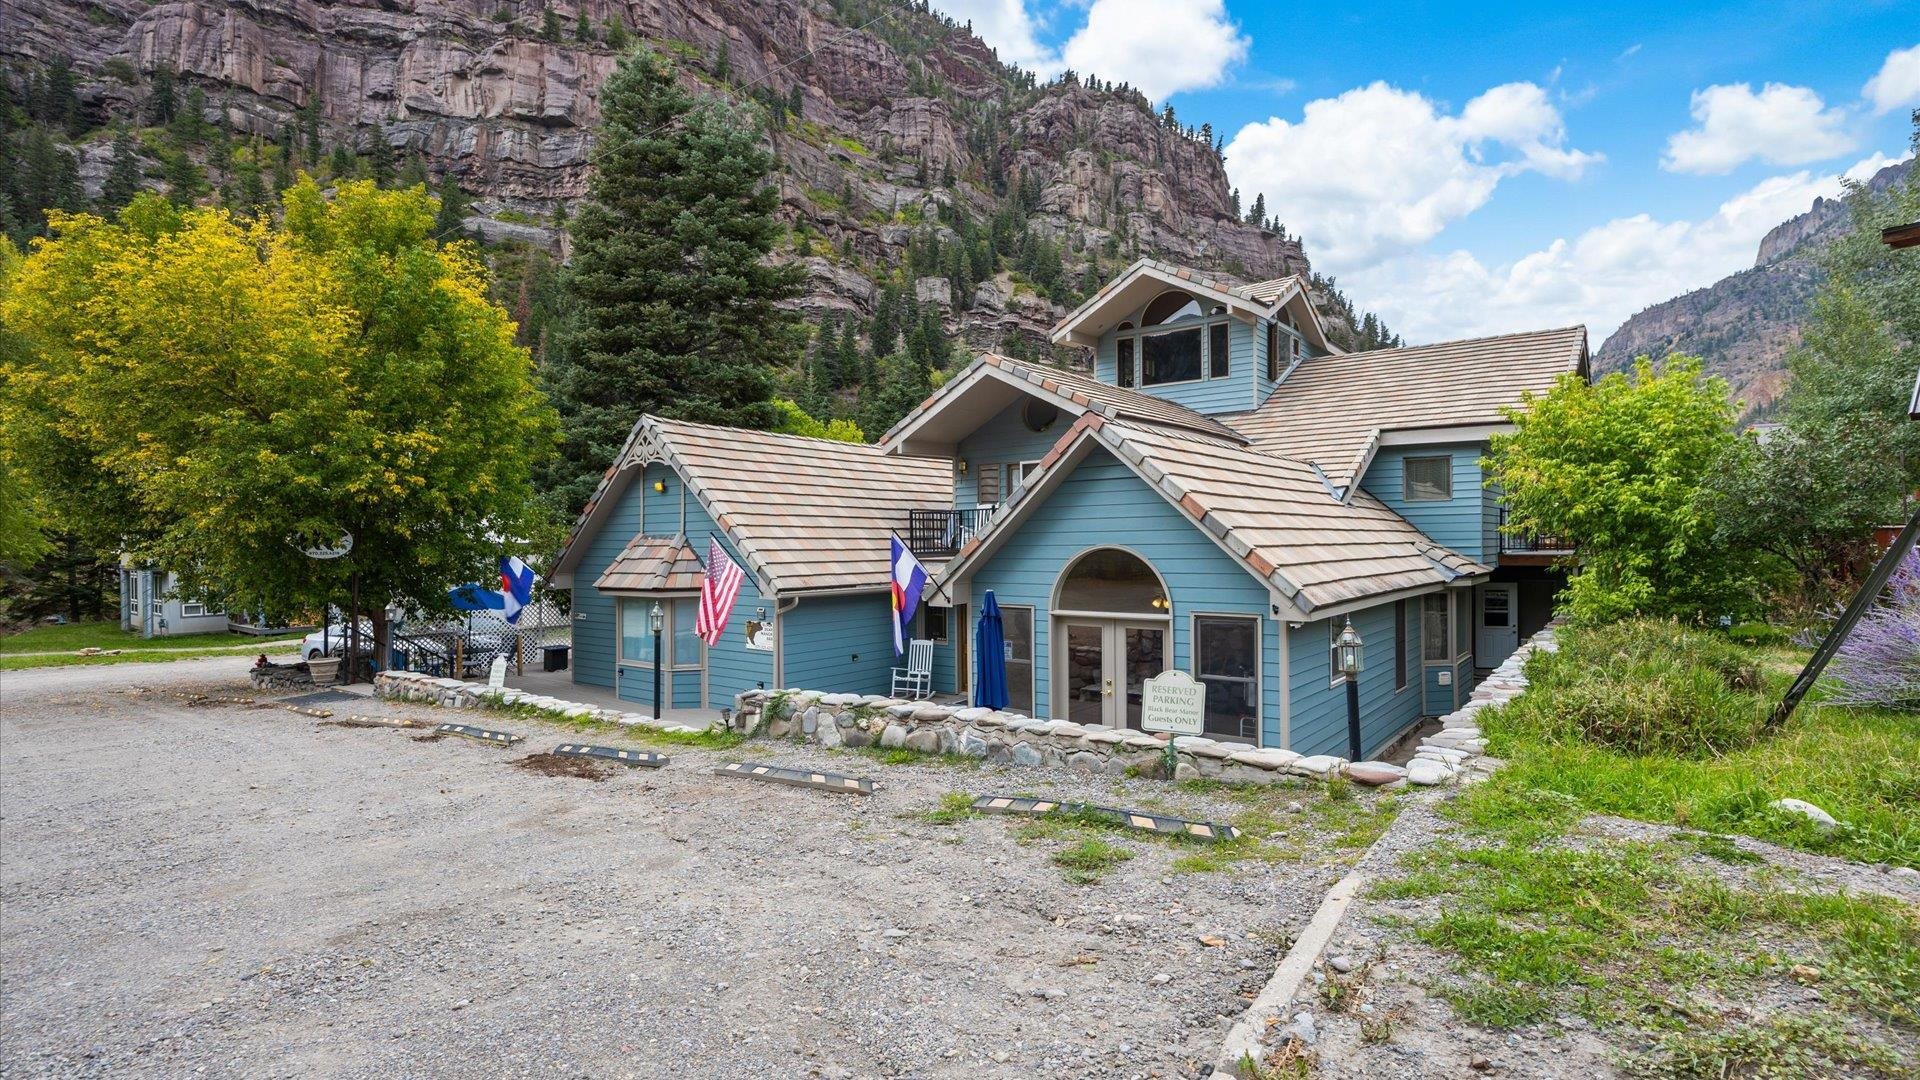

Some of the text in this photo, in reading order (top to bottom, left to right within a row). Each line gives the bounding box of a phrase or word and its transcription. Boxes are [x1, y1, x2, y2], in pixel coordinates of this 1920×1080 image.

[1152, 685, 1197, 696] RESERVED
[1153, 695, 1194, 706] PARKING
[1148, 714, 1198, 726] Guests ONLY
